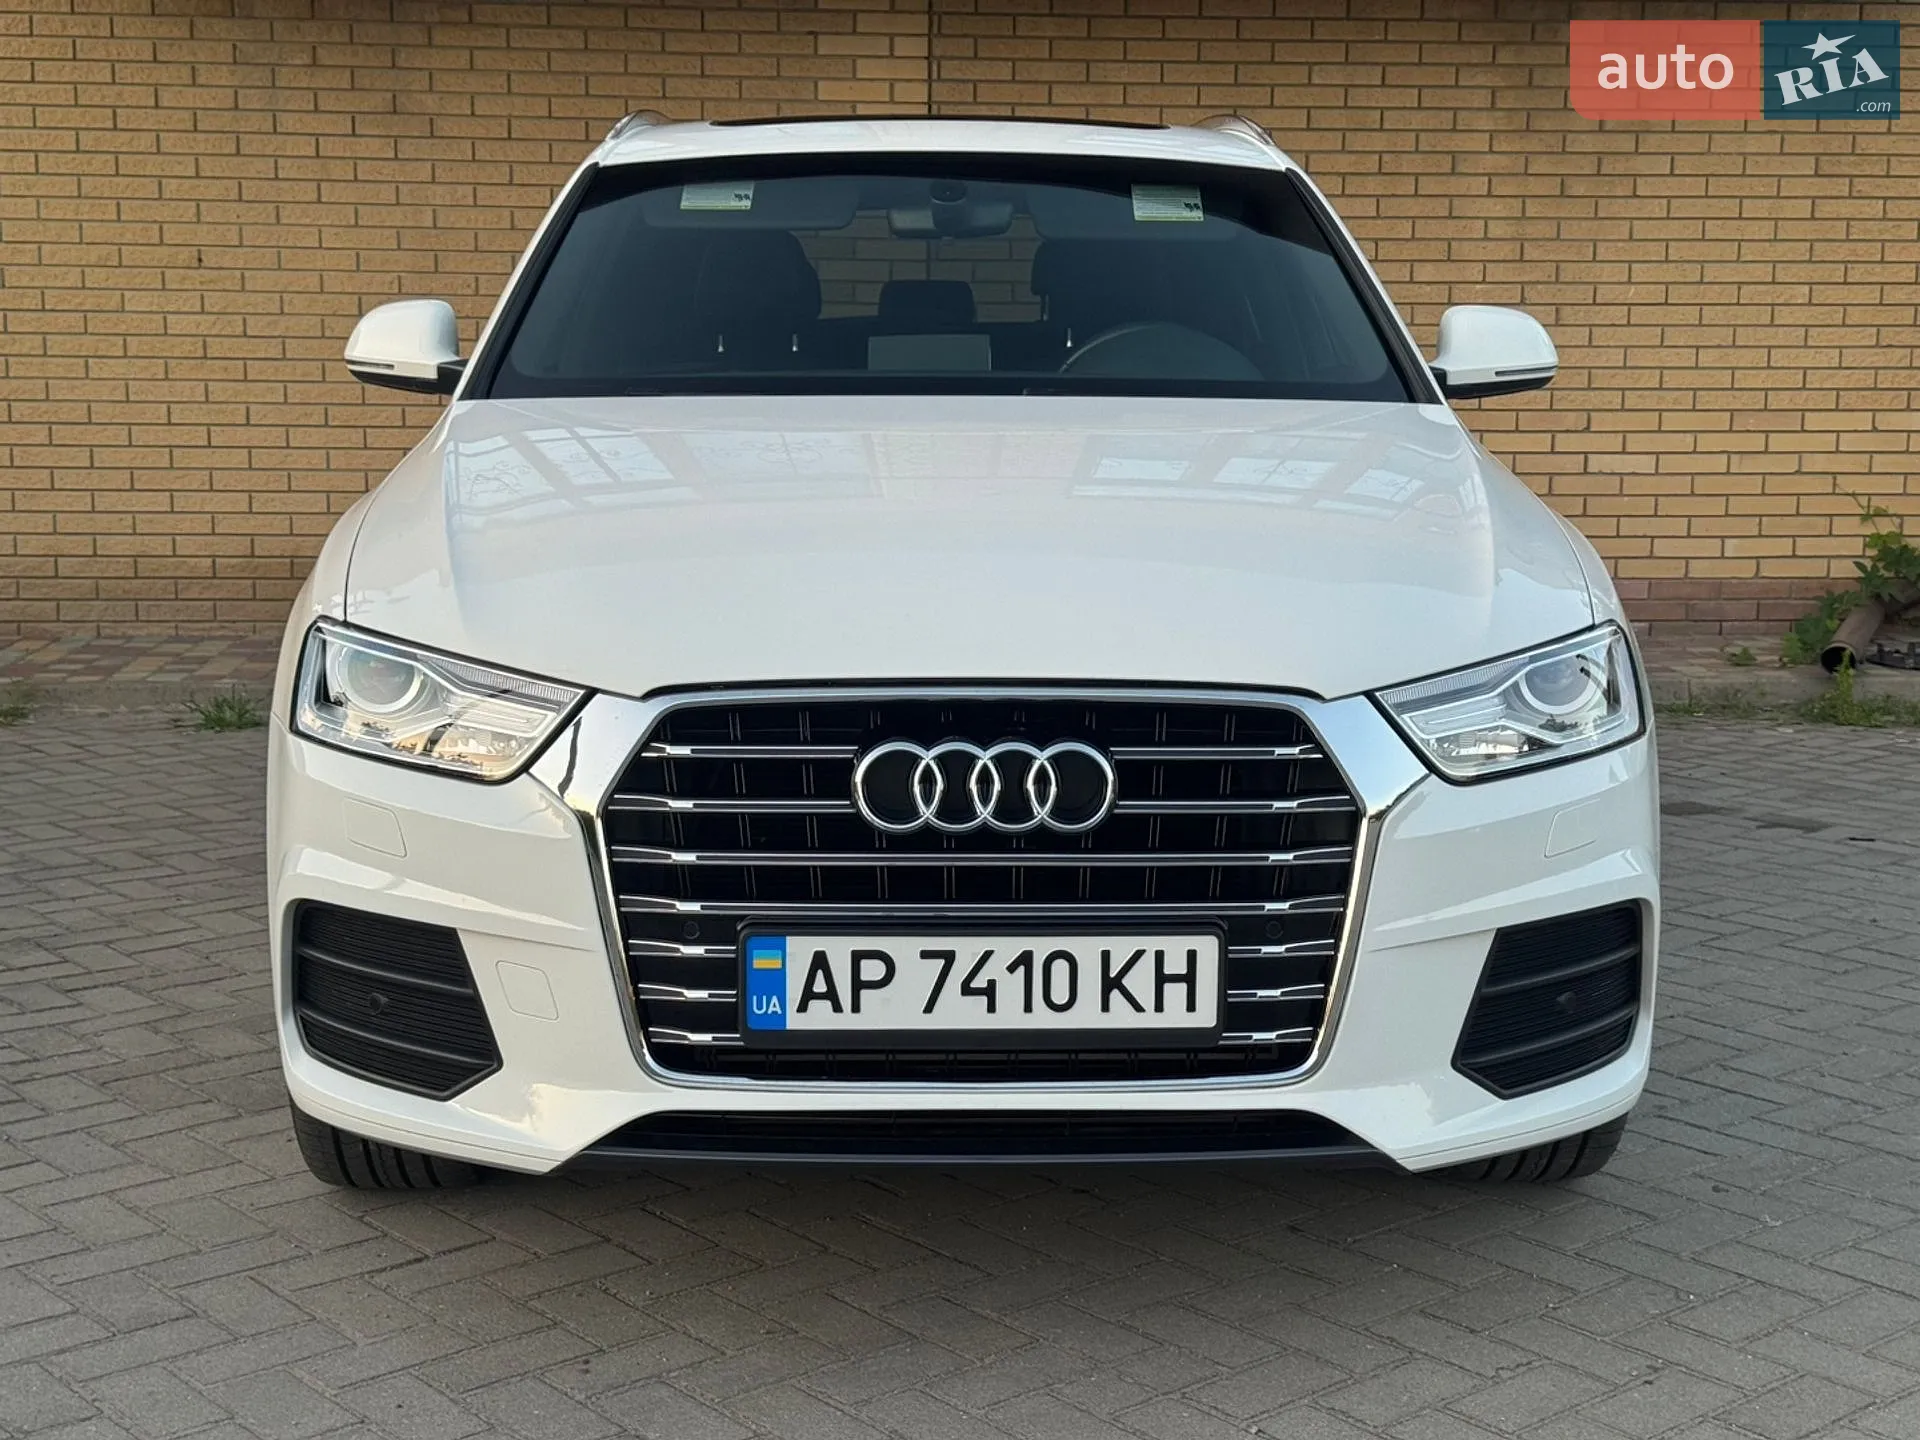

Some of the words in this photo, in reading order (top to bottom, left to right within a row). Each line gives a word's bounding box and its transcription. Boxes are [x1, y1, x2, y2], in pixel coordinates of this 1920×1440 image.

[796, 949, 896, 1014] AP
[919, 949, 1079, 1014] 7410
[1100, 949, 1198, 1014] KH
[752, 995, 783, 1016] UA
